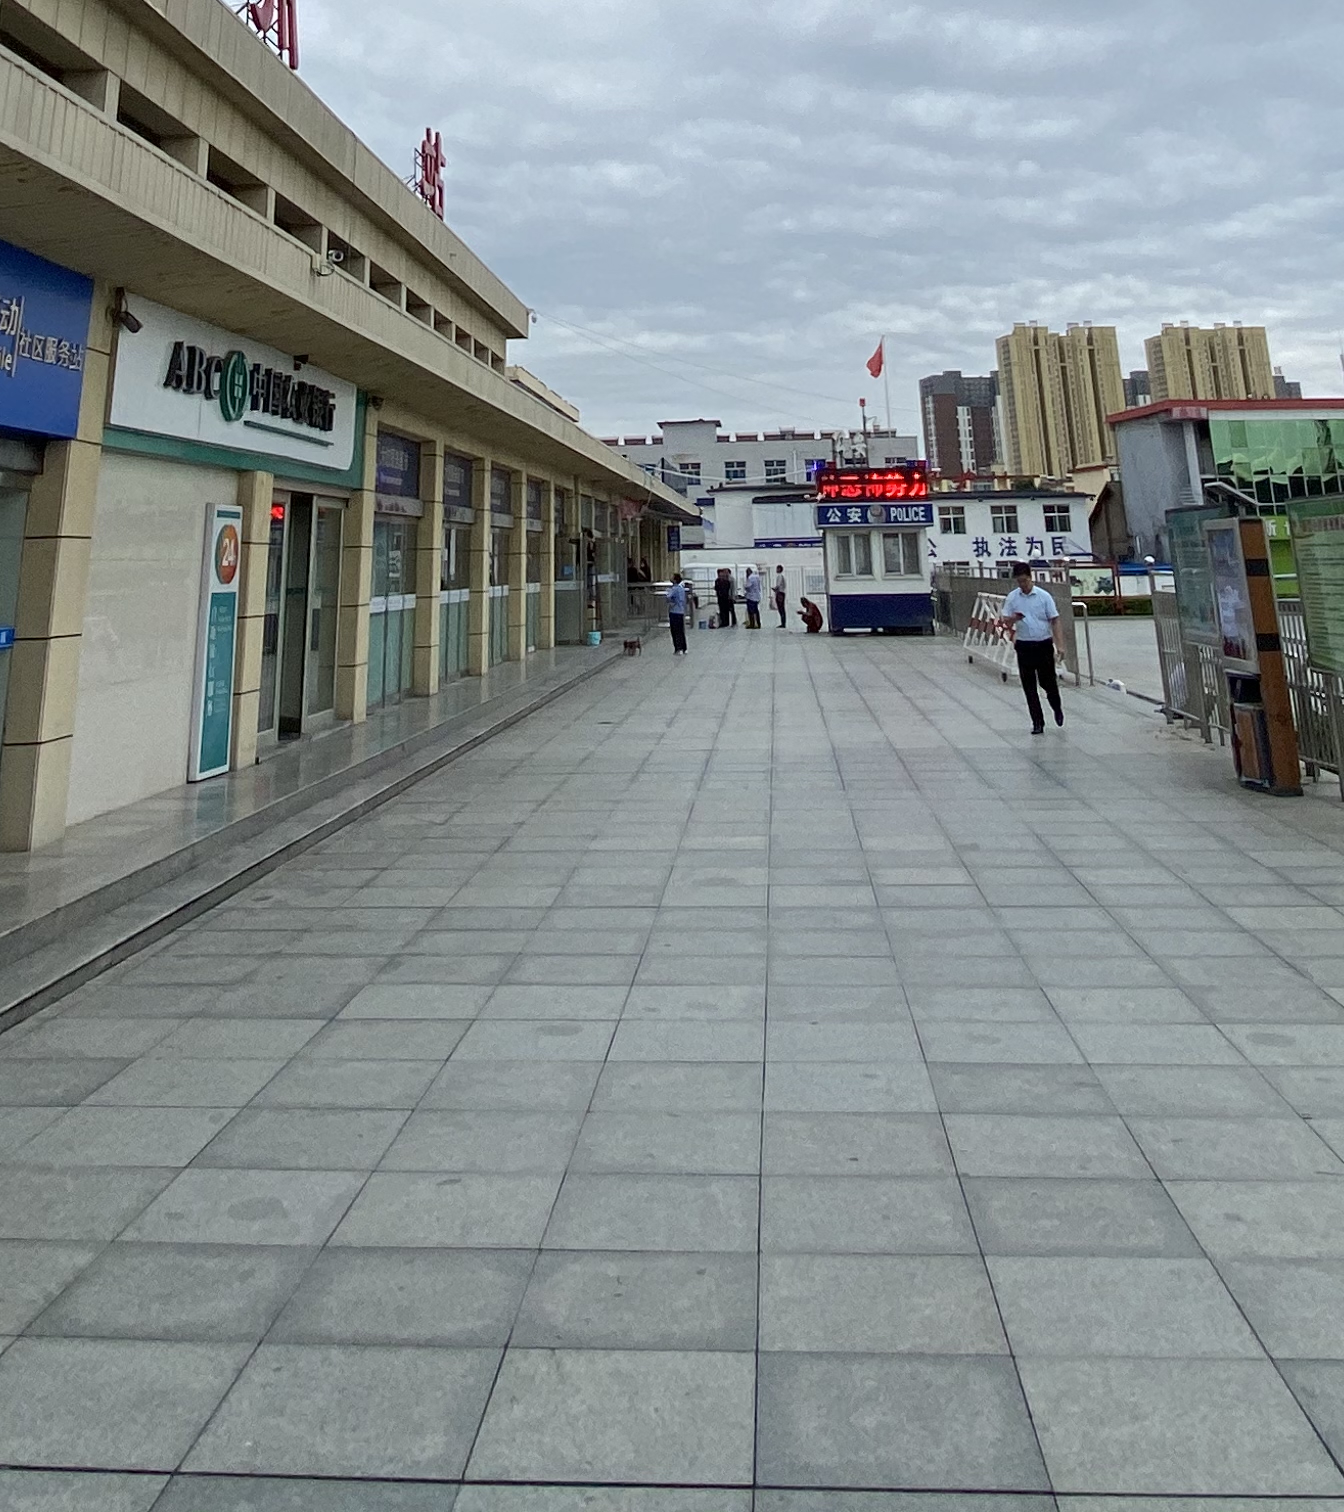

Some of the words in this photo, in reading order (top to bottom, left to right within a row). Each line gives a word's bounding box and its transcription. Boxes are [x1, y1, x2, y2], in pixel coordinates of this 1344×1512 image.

[19, 329, 84, 372] 社区服务站
[163, 341, 223, 400] ABC
[826, 507, 862, 523] 公安
[890, 506, 926, 522] POLICE
[972, 536, 1065, 558] 执法为民
